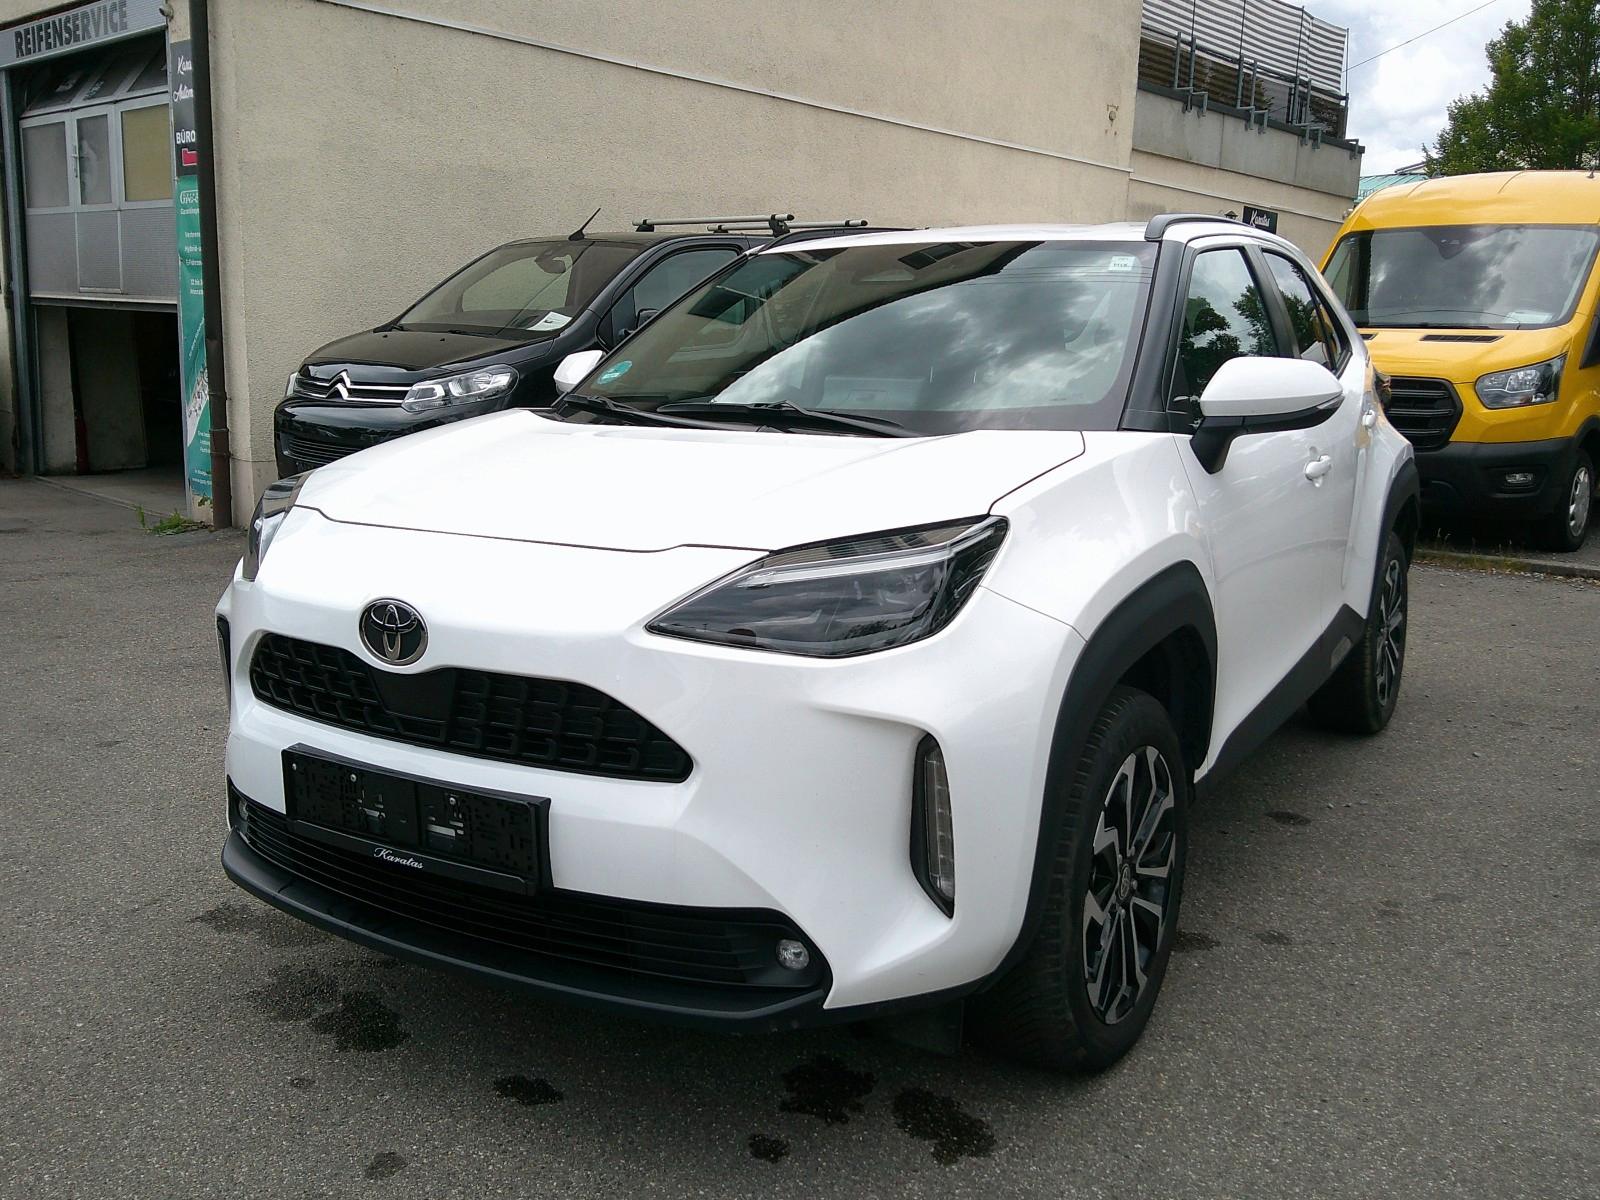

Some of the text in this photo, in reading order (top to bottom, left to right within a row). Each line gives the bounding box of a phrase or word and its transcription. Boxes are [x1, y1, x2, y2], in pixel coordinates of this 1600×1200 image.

[14, 0, 128, 58] REIFENSERVICE
[176, 129, 196, 144] BÜRO
[373, 847, 424, 869] Karatas
